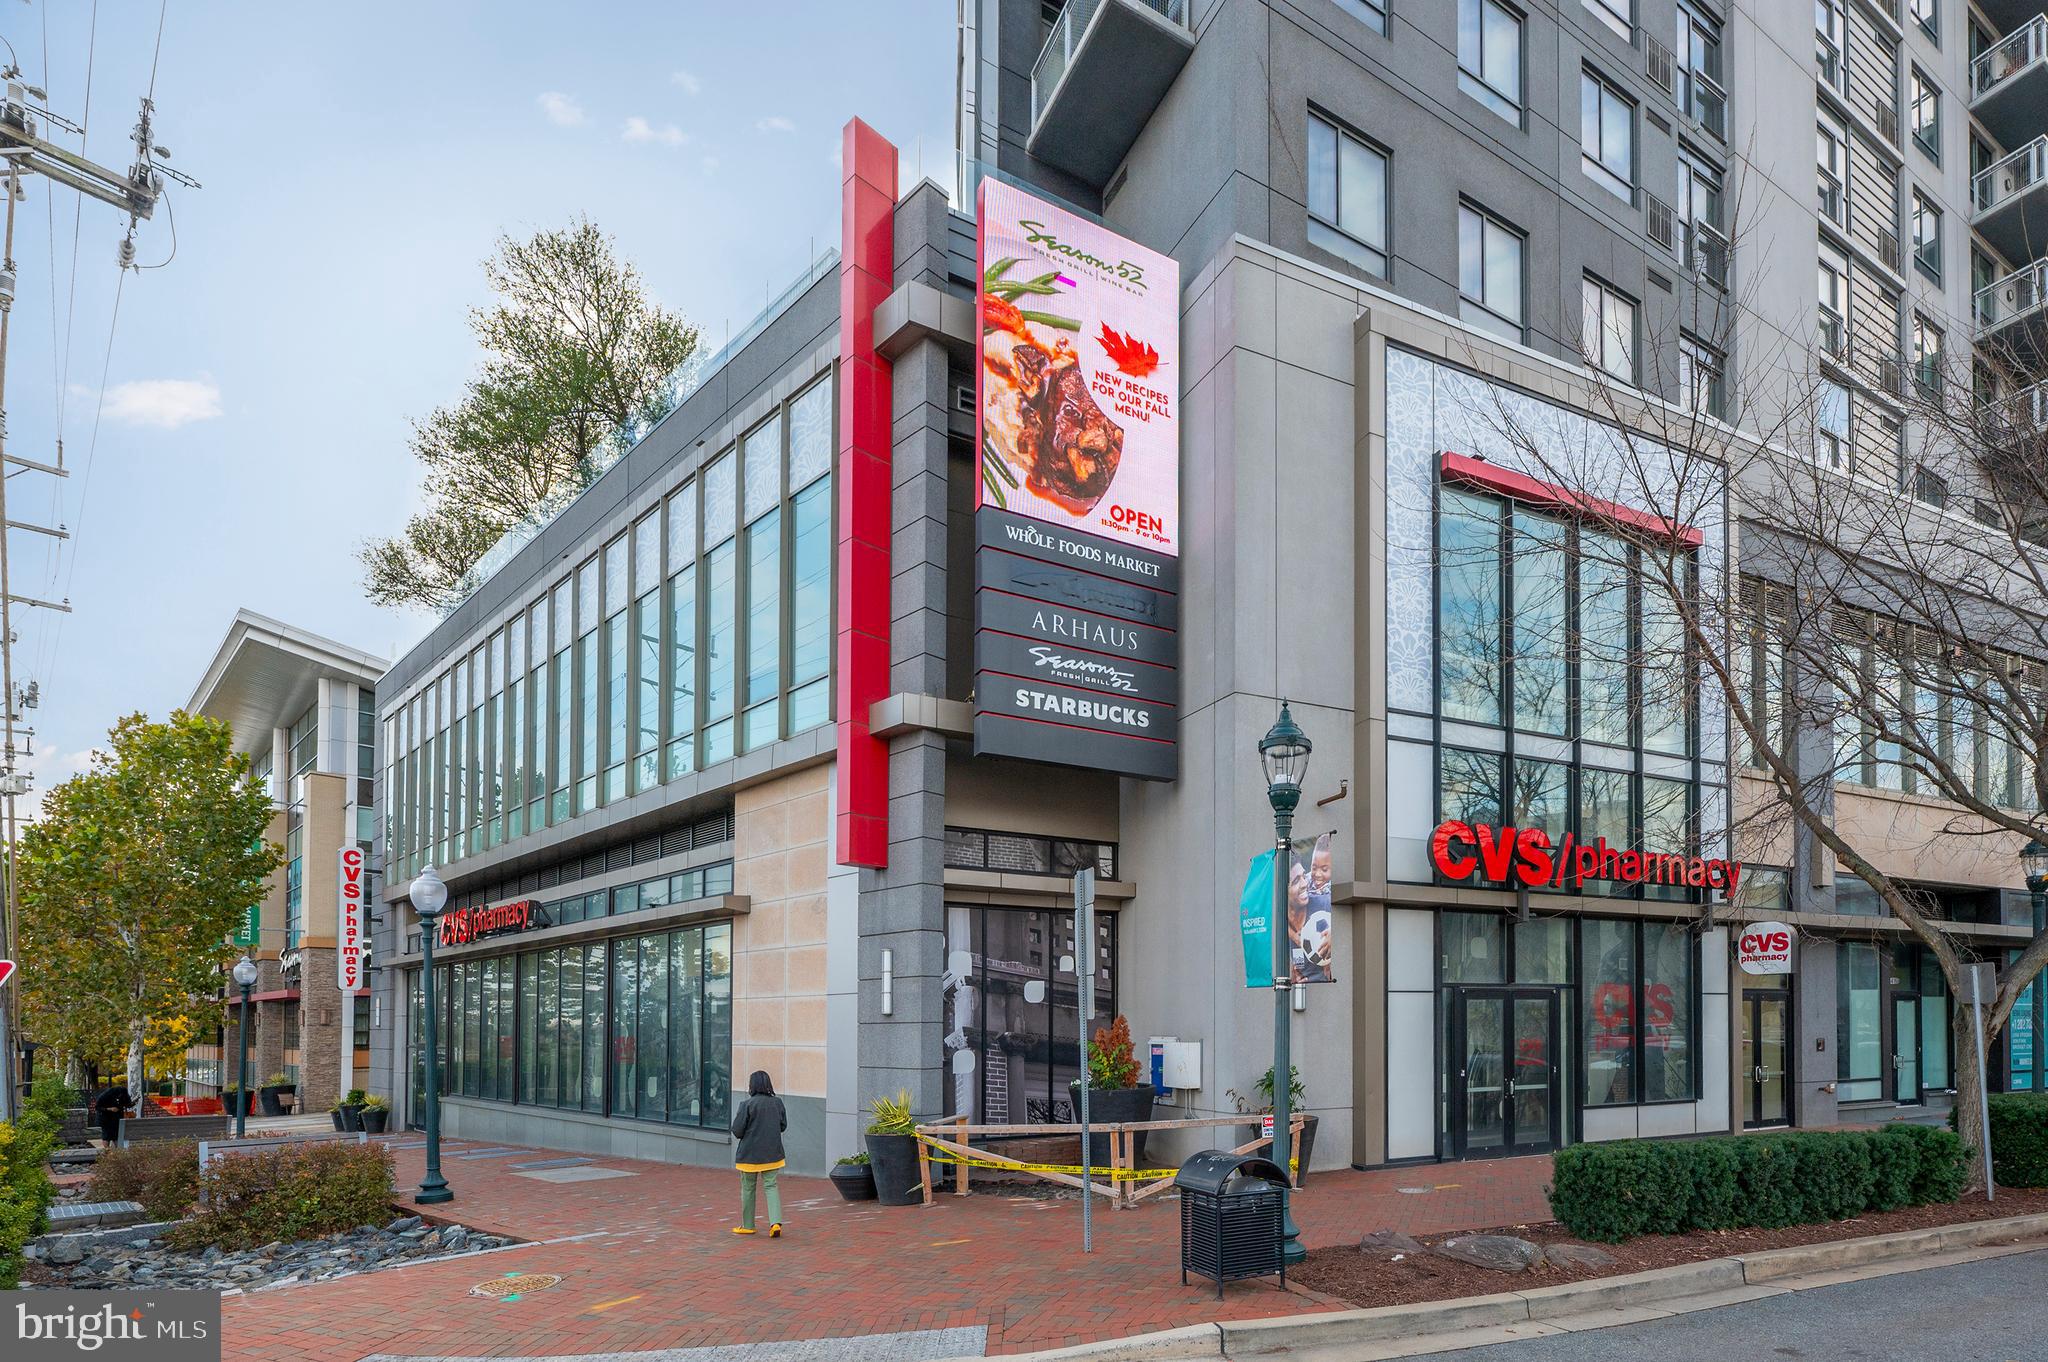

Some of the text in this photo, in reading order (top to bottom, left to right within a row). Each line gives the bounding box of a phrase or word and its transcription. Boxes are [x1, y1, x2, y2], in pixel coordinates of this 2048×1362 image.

[1019, 220, 1147, 289] Seasons 52
[1067, 262, 1094, 276] GRILL
[1100, 275, 1122, 288] WINE
[1126, 286, 1143, 297] BAR
[1092, 381, 1171, 418] FOR OUR FALL
[1095, 369, 1169, 405] NEW RECIPES
[1115, 402, 1151, 423] MENU!
[1101, 518, 1129, 532] 11:30pm
[1151, 533, 1171, 544] 10pm
[1110, 504, 1162, 534] OPEN
[1005, 525, 1161, 577] WHOLE FOODS MARKET
[1032, 610, 1138, 650] ARHAUS
[1028, 646, 1139, 692] Seasons 52
[1050, 670, 1110, 686] FRESH GRILL
[1015, 688, 1150, 728] STARBUCKS
[343, 850, 361, 898] CVS
[343, 903, 359, 986] pharmacy
[1740, 932, 1789, 953] CVS
[1741, 954, 1788, 964] pharmacy
